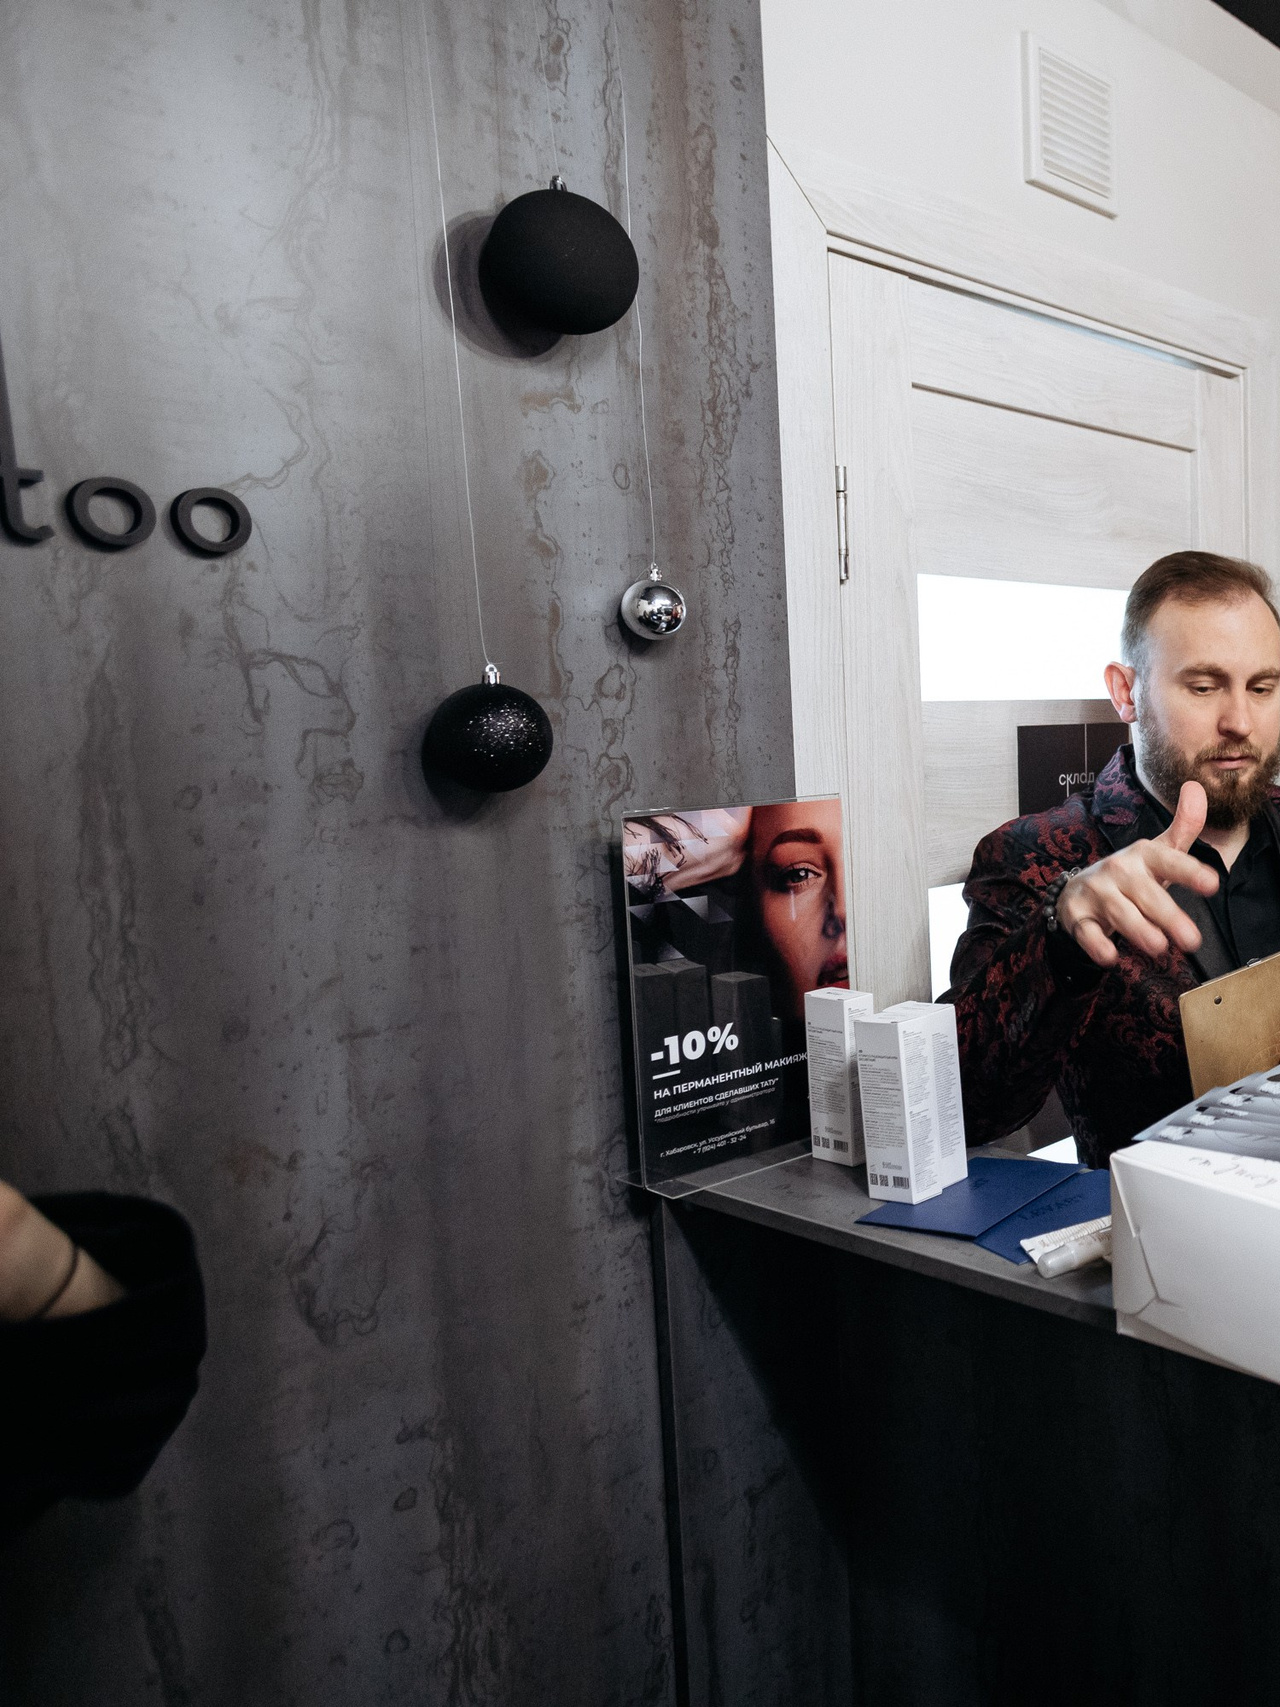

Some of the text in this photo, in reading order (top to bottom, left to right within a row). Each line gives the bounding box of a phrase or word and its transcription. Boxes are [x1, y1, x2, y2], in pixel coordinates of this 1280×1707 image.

[1058, 771, 1095, 786] склад
[650, 1022, 739, 1065] -10%
[653, 1051, 808, 1100] НА ПЕРМАНЕНТНЫЙ МАКИЯЖ
[654, 1106, 672, 1118] ДЛЯ
[673, 1096, 714, 1112] КЛИЕНТОВ
[714, 1084, 760, 1101] СДЕЛАВШИХ
